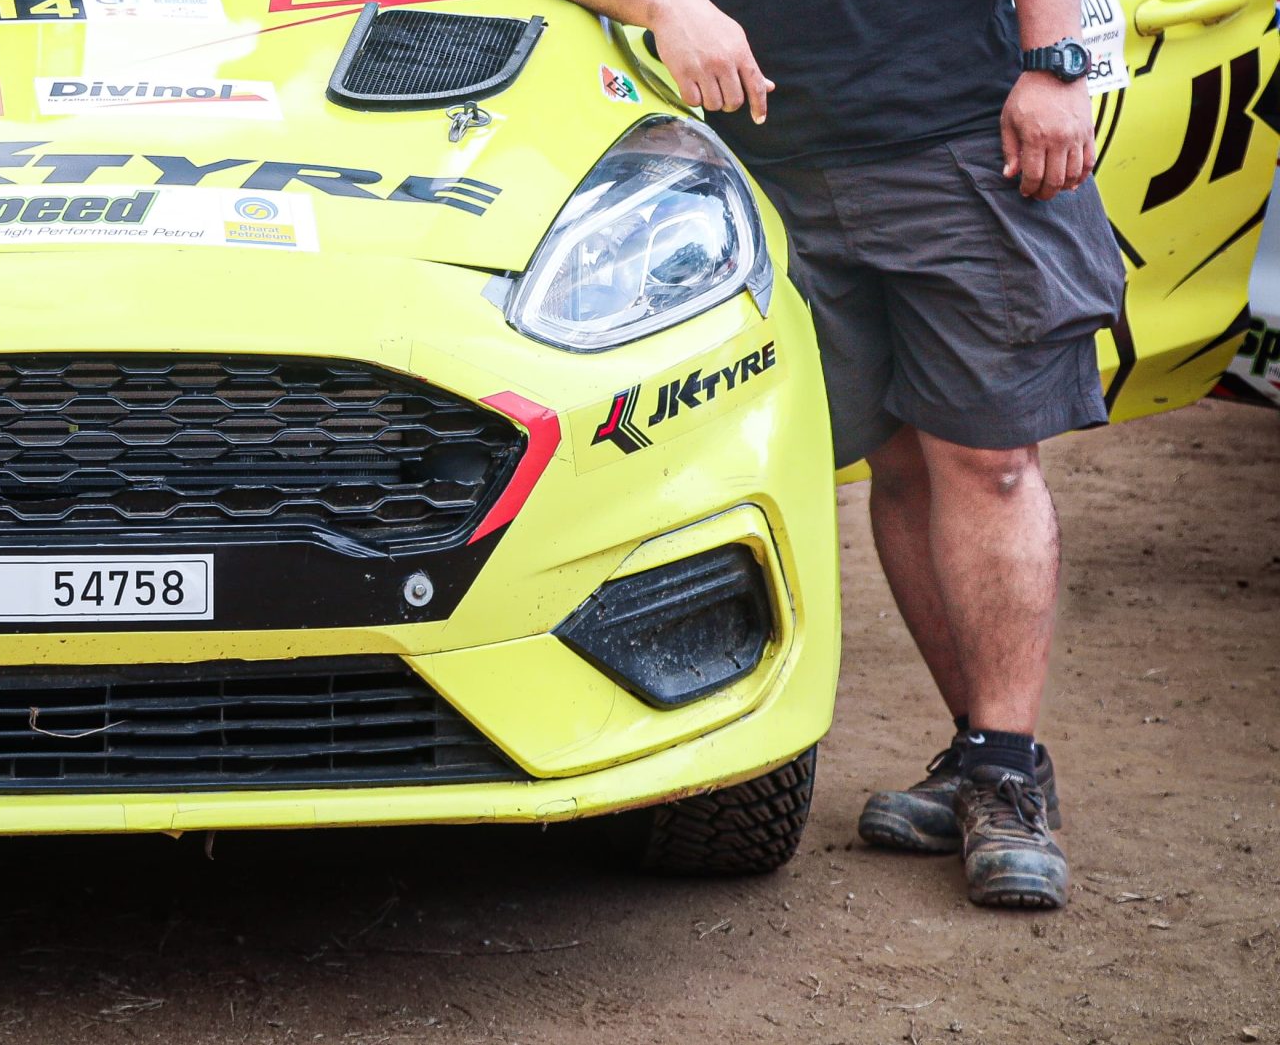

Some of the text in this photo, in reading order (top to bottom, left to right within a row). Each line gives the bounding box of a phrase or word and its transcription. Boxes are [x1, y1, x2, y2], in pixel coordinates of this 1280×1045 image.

[49, 81, 233, 100] Divinol
[36, 226, 149, 238] Performance
[152, 227, 205, 239] Petrol
[238, 224, 281, 234] Bharat
[228, 230, 293, 242] Petroleum
[53, 569, 185, 607] 54758
